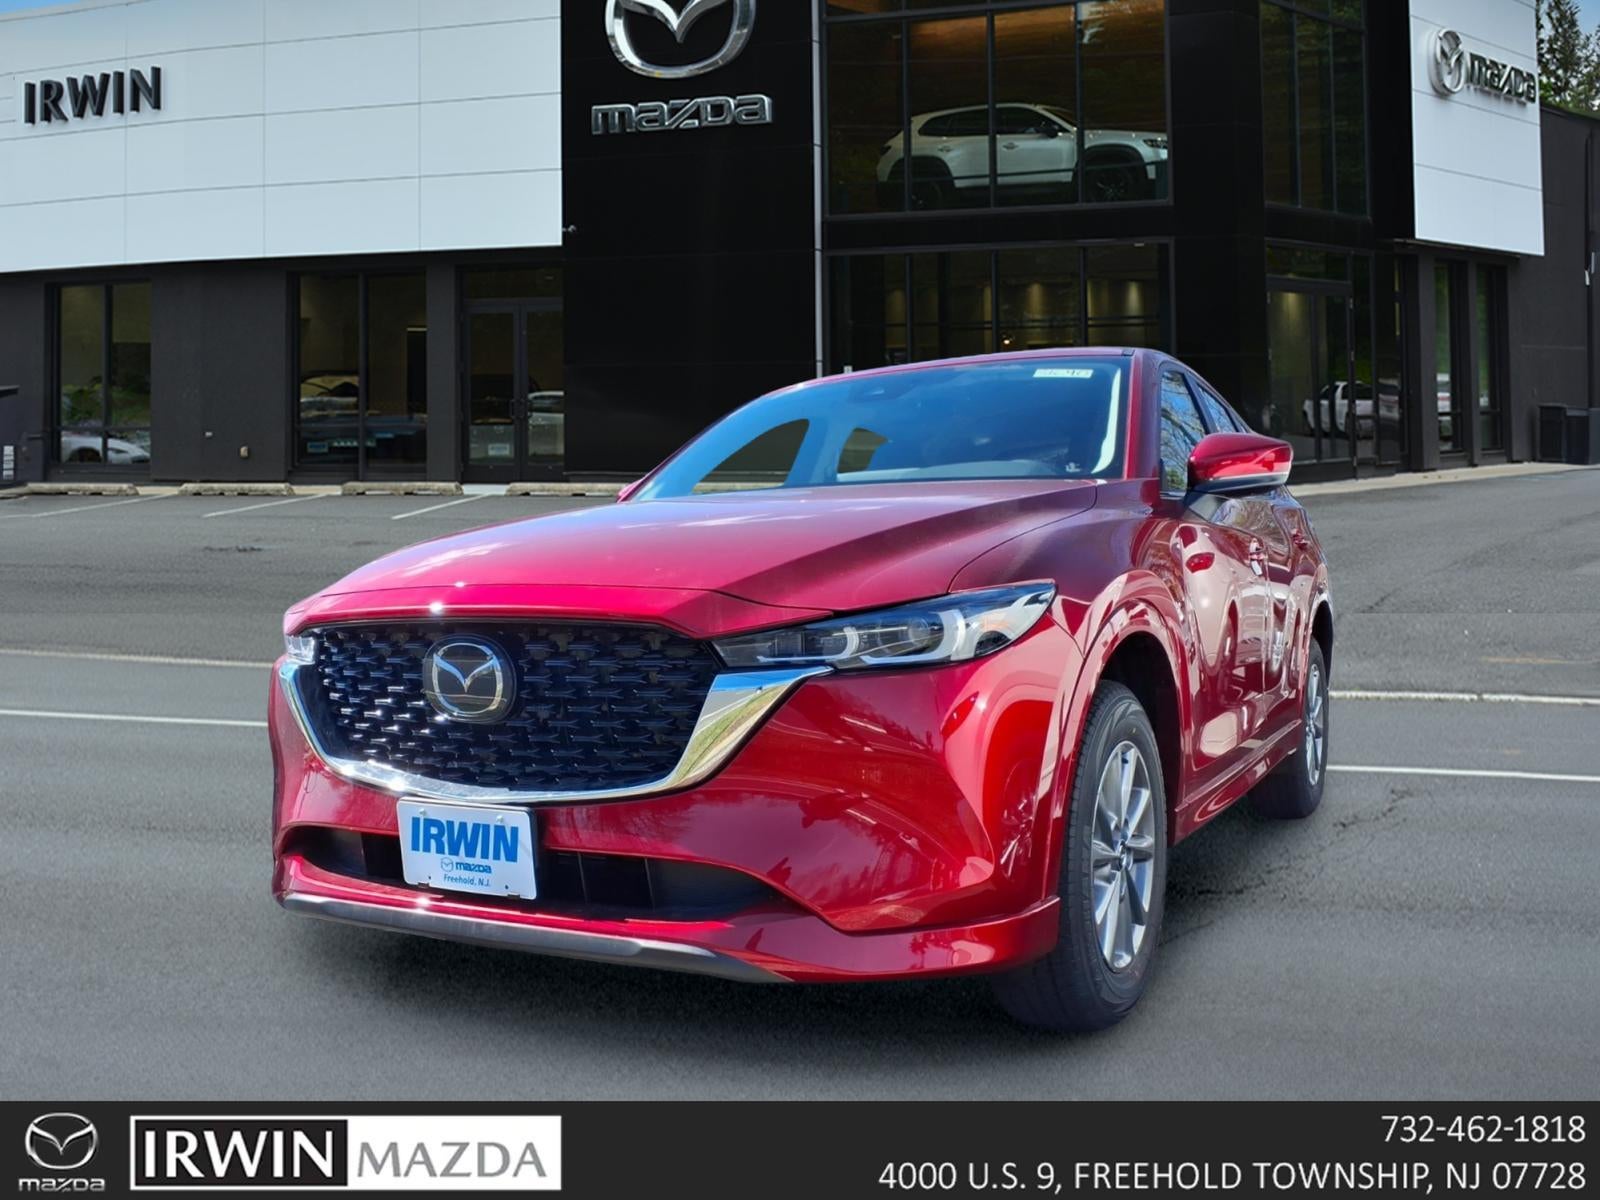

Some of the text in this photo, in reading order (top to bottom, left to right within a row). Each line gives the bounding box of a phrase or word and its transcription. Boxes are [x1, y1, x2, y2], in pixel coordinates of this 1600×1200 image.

[24, 66, 162, 125] IRWIN
[591, 94, 772, 135] mazda
[411, 816, 519, 863] IRWIN
[443, 873, 491, 887] Freehold, N.J.
